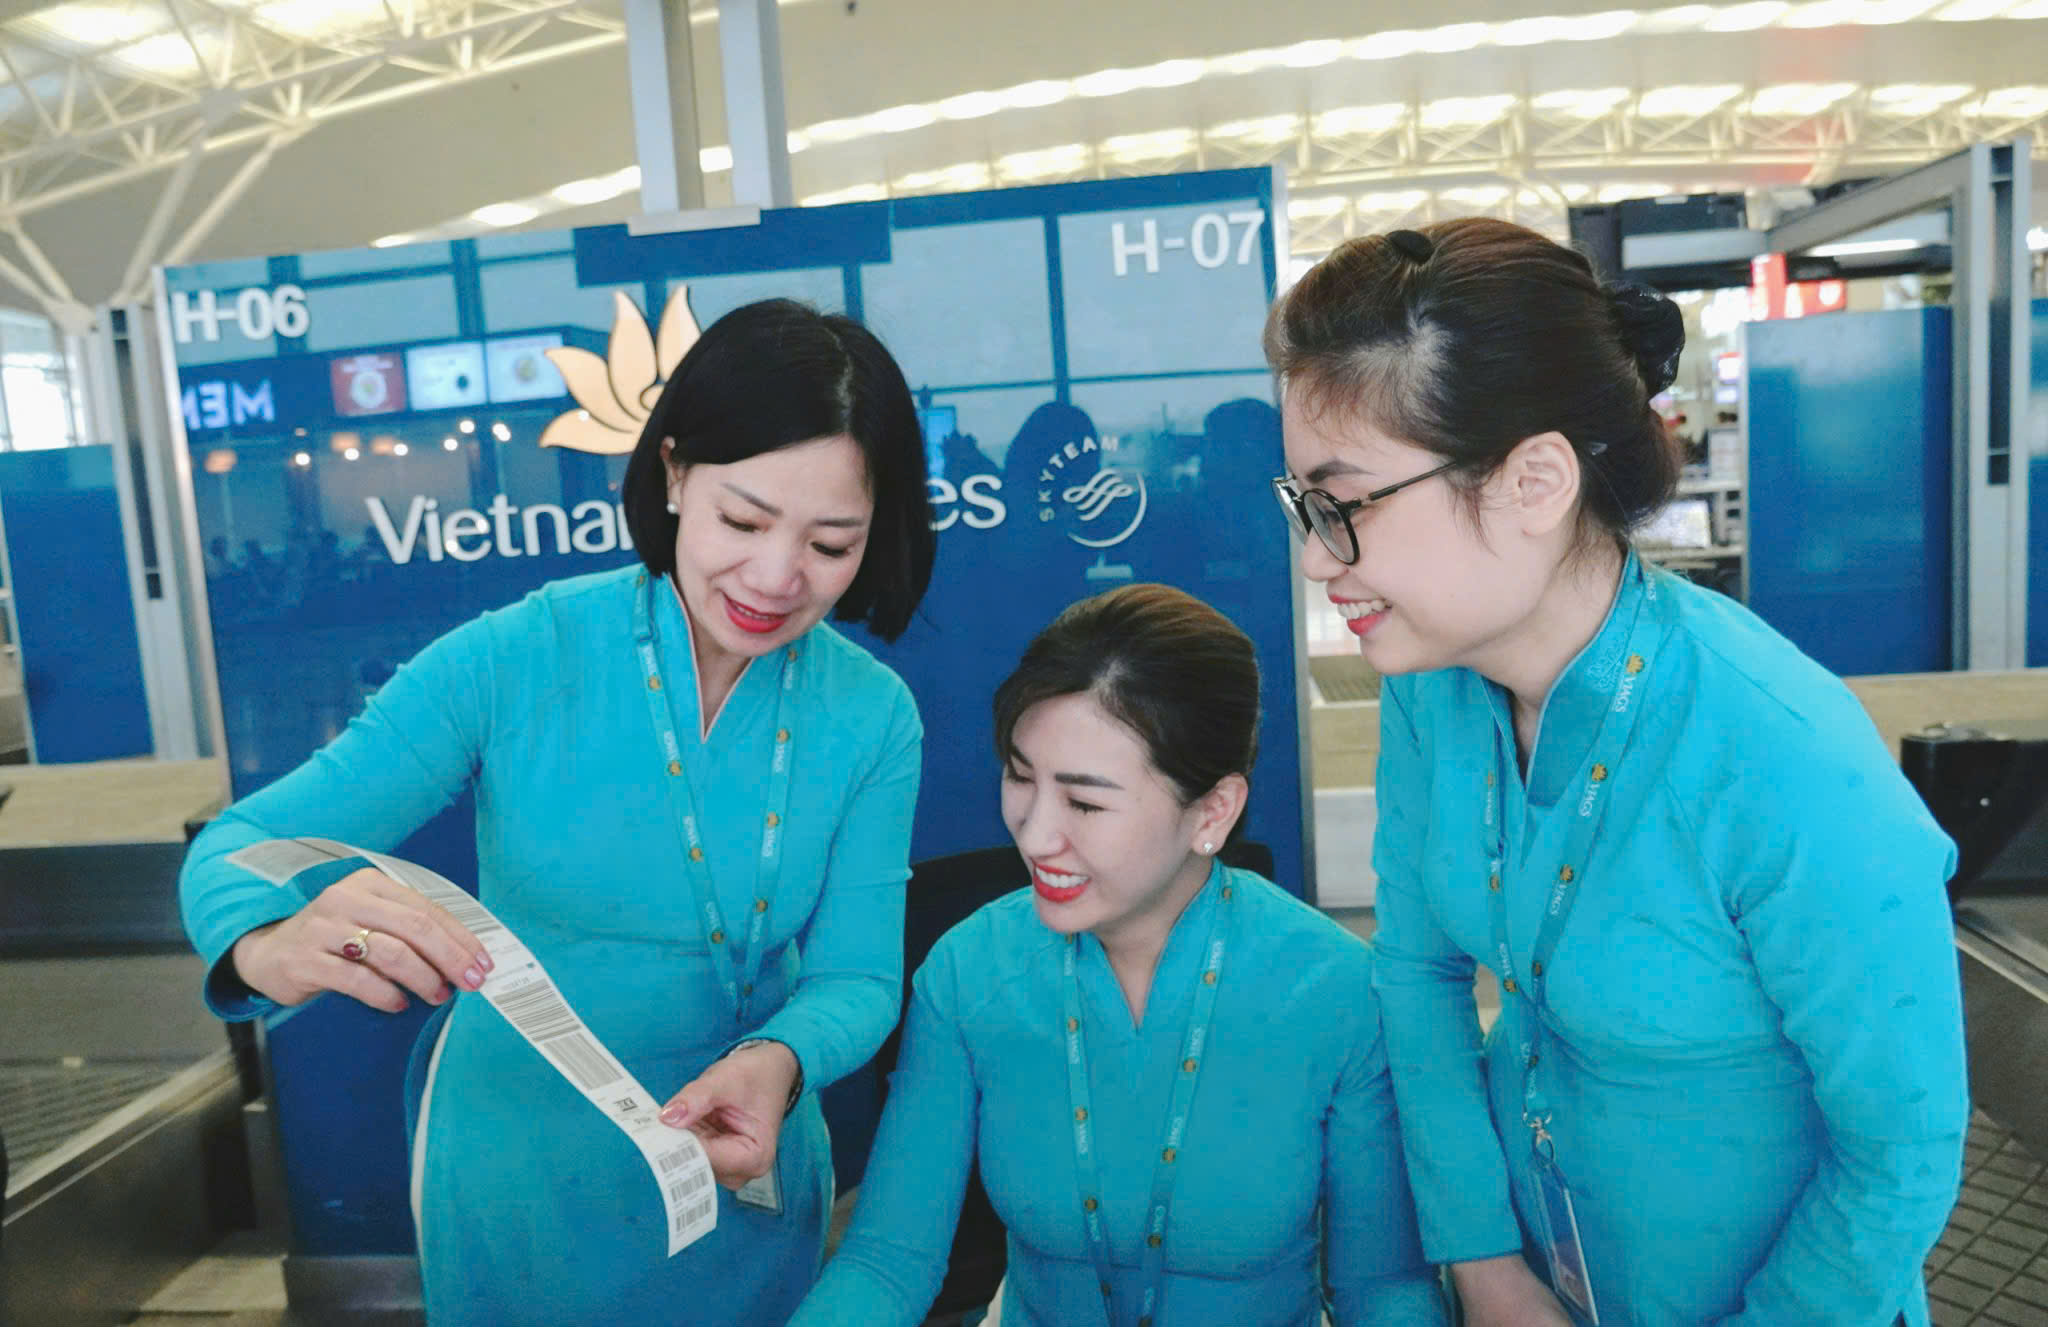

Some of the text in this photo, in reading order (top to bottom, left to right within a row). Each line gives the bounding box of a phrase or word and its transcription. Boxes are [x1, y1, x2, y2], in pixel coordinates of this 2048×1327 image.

[1111, 209, 1266, 277] H-07
[171, 285, 311, 346] H-06
[1038, 434, 1120, 523] SKYTEAM
